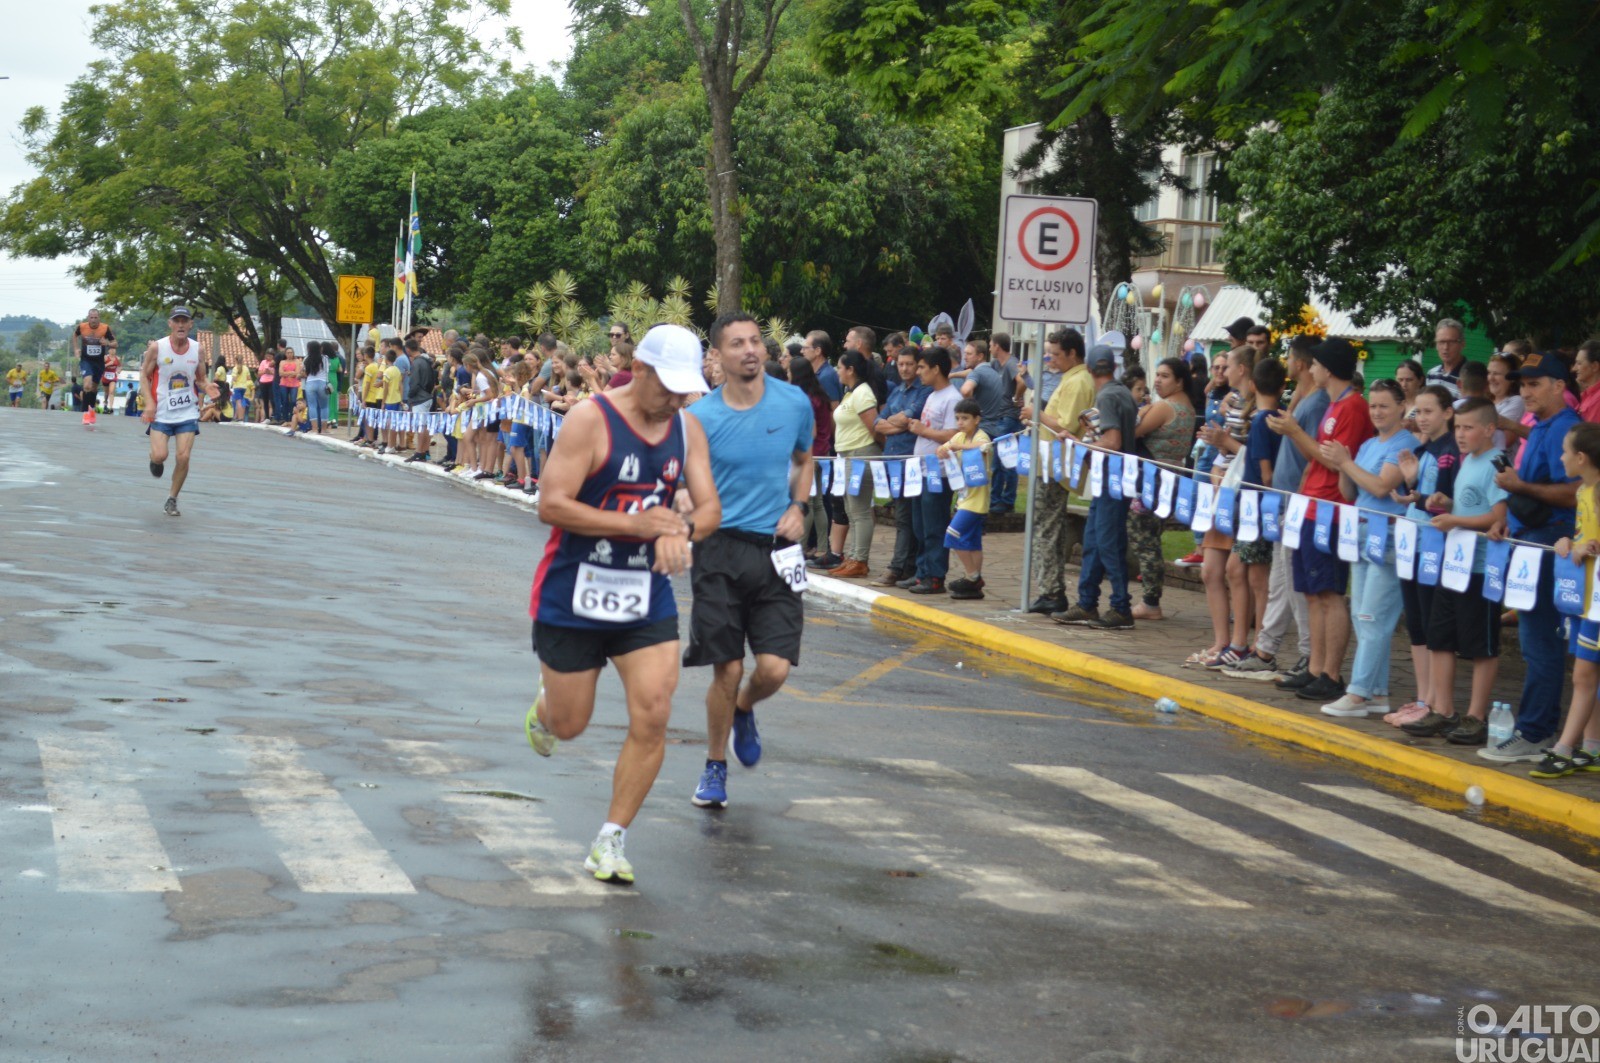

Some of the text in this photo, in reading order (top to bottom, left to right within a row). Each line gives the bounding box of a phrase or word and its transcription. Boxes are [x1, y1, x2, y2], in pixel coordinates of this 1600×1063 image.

[1038, 222, 1060, 256] E
[1008, 278, 1084, 295] EXCLUSIVO
[1031, 295, 1060, 311] TÁXI
[169, 394, 192, 408] 644
[580, 588, 642, 616] 662
